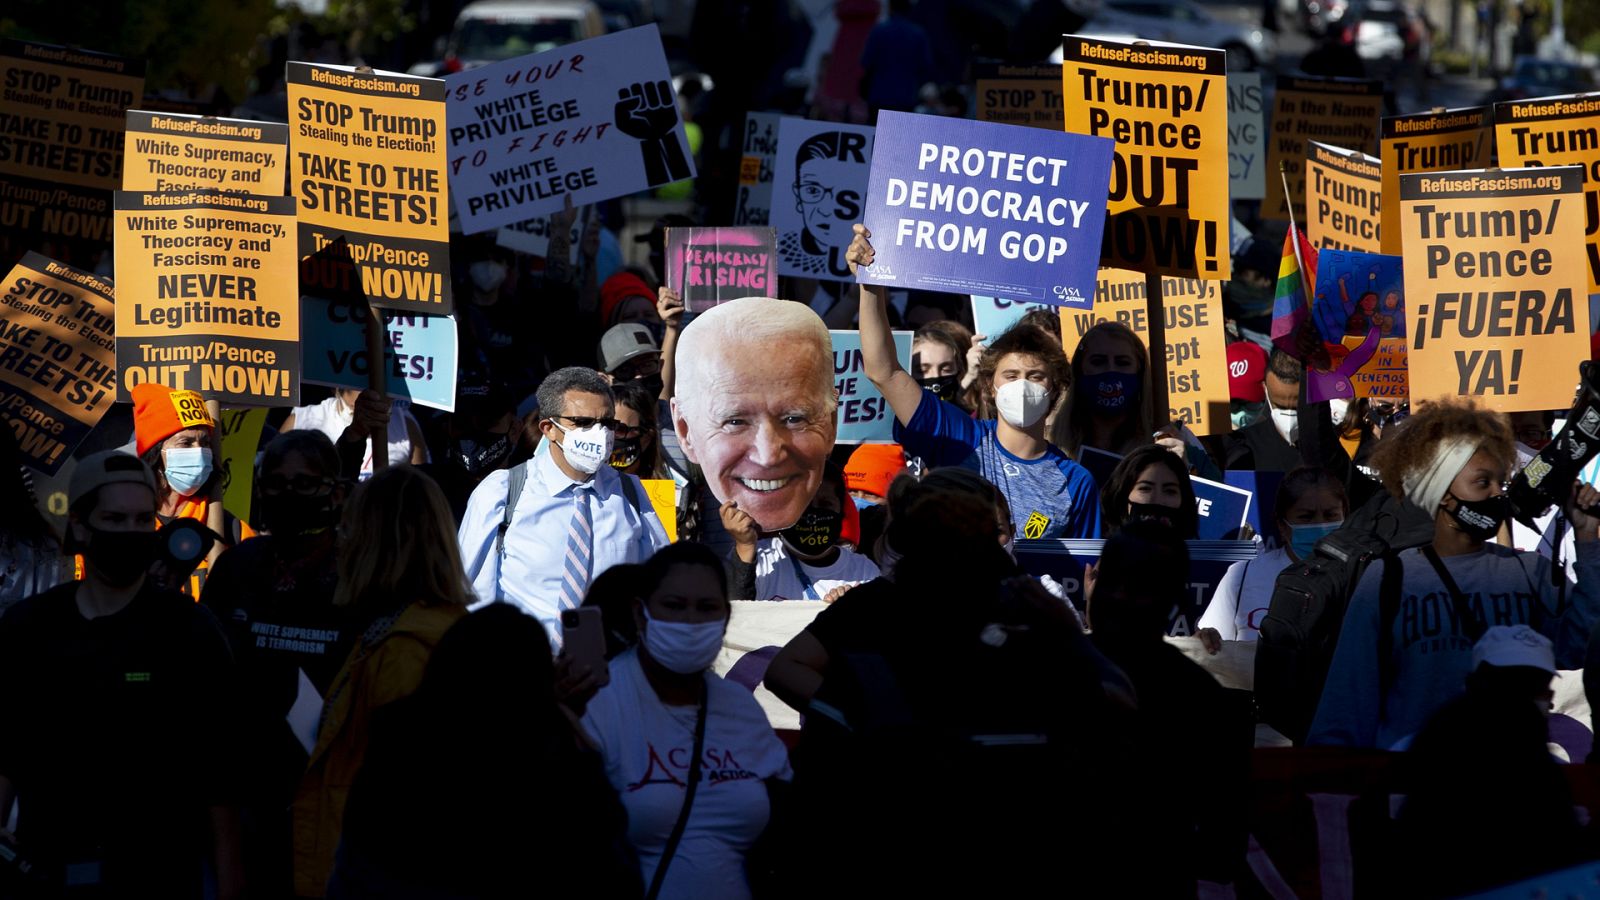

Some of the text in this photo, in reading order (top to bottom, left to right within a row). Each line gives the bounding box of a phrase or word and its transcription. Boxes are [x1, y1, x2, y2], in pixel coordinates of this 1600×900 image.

[505, 54, 585, 88] YOUR
[1080, 42, 1208, 70] RefuseFascism.org
[5, 67, 134, 111] STOP Trump
[311, 67, 420, 97] RefuseFascism.org
[1078, 67, 1212, 118] Trump/
[3, 89, 52, 110] Stealing
[55, 96, 76, 112] the
[474, 89, 543, 121] WHITE
[985, 89, 1063, 108] STOP Tr
[1280, 99, 1376, 118] In the Name
[0, 113, 124, 151] TAKE TO THE
[151, 117, 261, 141] RefuseFascism.org
[297, 97, 437, 141] STOP Trump
[450, 99, 581, 147] PRIVILEGE
[1089, 107, 1202, 150] Pence
[1275, 118, 1292, 133] of
[1394, 112, 1484, 133] RefuseFascism.org
[136, 138, 276, 168] White Supremacy,
[299, 123, 437, 154] Stealing the Election!
[451, 122, 613, 177] TO FIGHT
[1393, 132, 1482, 171] Trump/
[0, 136, 121, 179] STREETS!
[147, 159, 261, 184] Theocracy and
[298, 152, 440, 193] TAKE TO THE
[490, 156, 559, 187] WHITE
[918, 142, 1069, 188] PROTECT
[1, 180, 107, 213] Trump/Pence
[467, 167, 598, 217] PRIVILEGE
[1420, 174, 1563, 194] RefuseFascism.org
[143, 194, 269, 212] RefuseFascism.org
[300, 179, 438, 227] STREETS!
[886, 178, 1091, 229] DEMOCRACY
[41, 207, 114, 243] NOW!
[127, 215, 287, 239] White Supremacy,
[1413, 198, 1561, 244] Trump/
[141, 235, 271, 253] Theocracy and
[312, 232, 430, 268] Trump/Pence
[896, 218, 1069, 265] FROM GOP
[153, 253, 261, 270] Fascism are
[685, 249, 769, 267] DEMOCRACY
[1427, 245, 1552, 280] Pence
[158, 274, 257, 302] NEVER
[361, 265, 443, 304] NOW!
[688, 265, 766, 289] RISING
[1053, 285, 1081, 297] CASA
[1096, 277, 1216, 303] Humnity,
[9, 277, 74, 309] STOP
[1, 293, 53, 322] Stealing
[55, 313, 76, 331] the
[134, 302, 282, 329] Legitimate
[1116, 303, 1210, 333] REUSE
[1414, 287, 1576, 350] ¡FUERA
[0, 318, 116, 391] AKE TO THE
[138, 342, 277, 364] Trump/Pence
[1378, 358, 1392, 367] IN
[1380, 344, 1394, 355] WE
[0, 342, 106, 412] REETS!
[124, 364, 291, 397] OUT NOW!
[1229, 359, 1249, 378] W
[1355, 372, 1406, 384] TENEMOS
[1454, 349, 1525, 397] YA!
[179, 399, 205, 410] OUT
[180, 410, 211, 423] NOW
[574, 440, 603, 455] VOTE
[799, 533, 830, 547] Vote
[250, 621, 341, 643] WHITE SUPREMACY
[255, 634, 327, 655] IS TERRORISM
